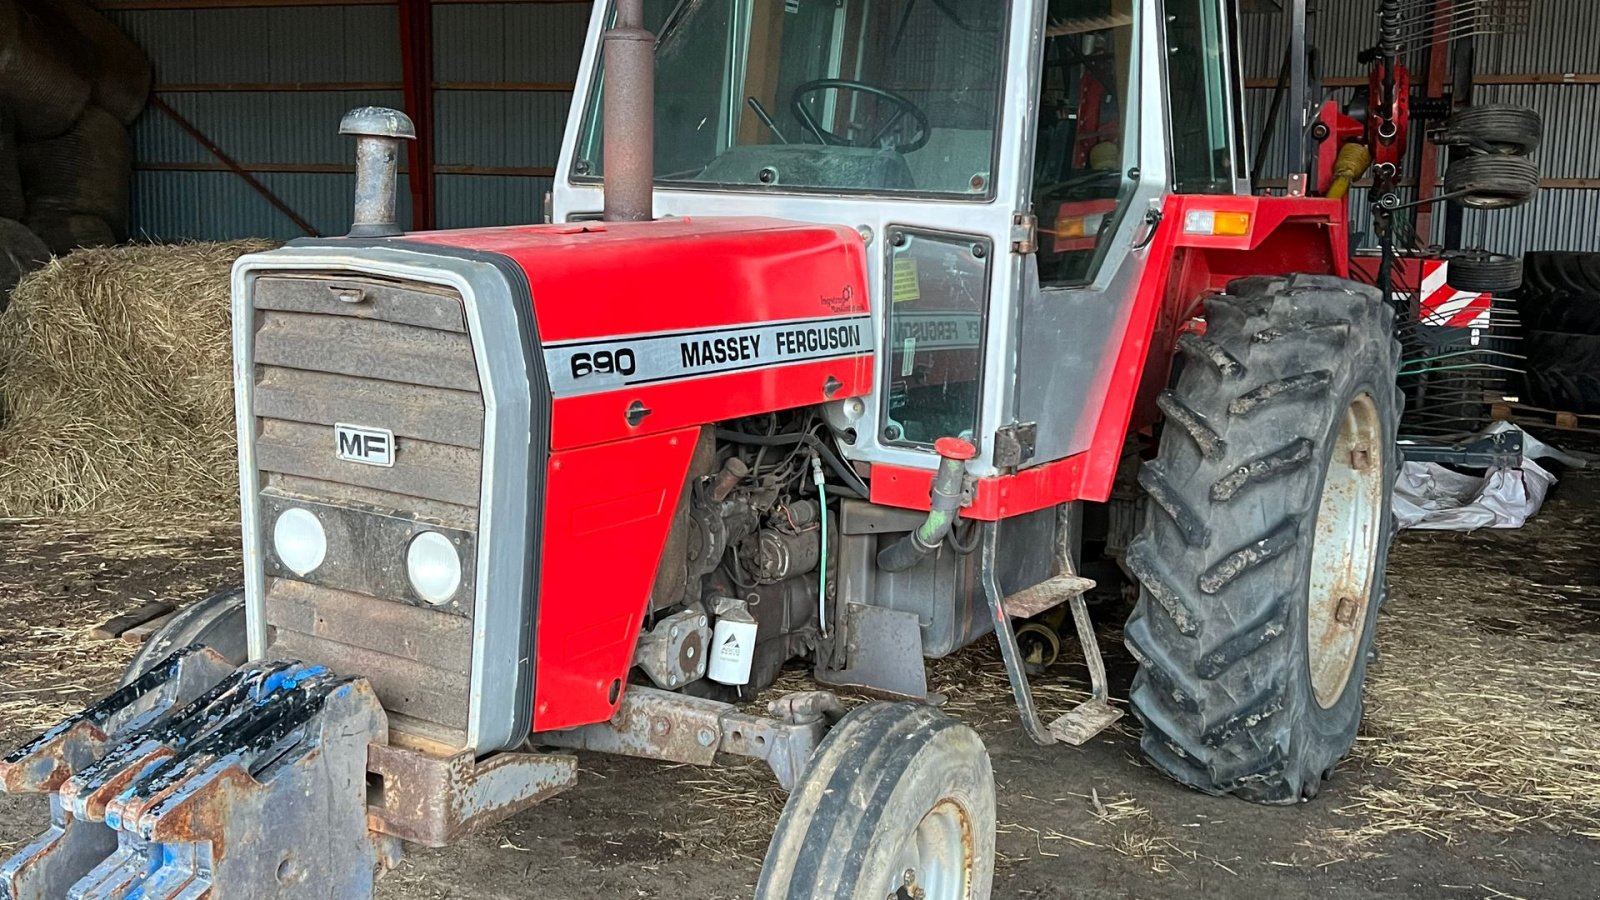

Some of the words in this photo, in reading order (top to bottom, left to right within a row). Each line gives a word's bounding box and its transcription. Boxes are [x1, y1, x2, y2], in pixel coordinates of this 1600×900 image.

[570, 347, 636, 380] 690
[680, 334, 761, 368] MASSEY
[776, 324, 861, 355] FERGUSON
[339, 431, 386, 457] MF
